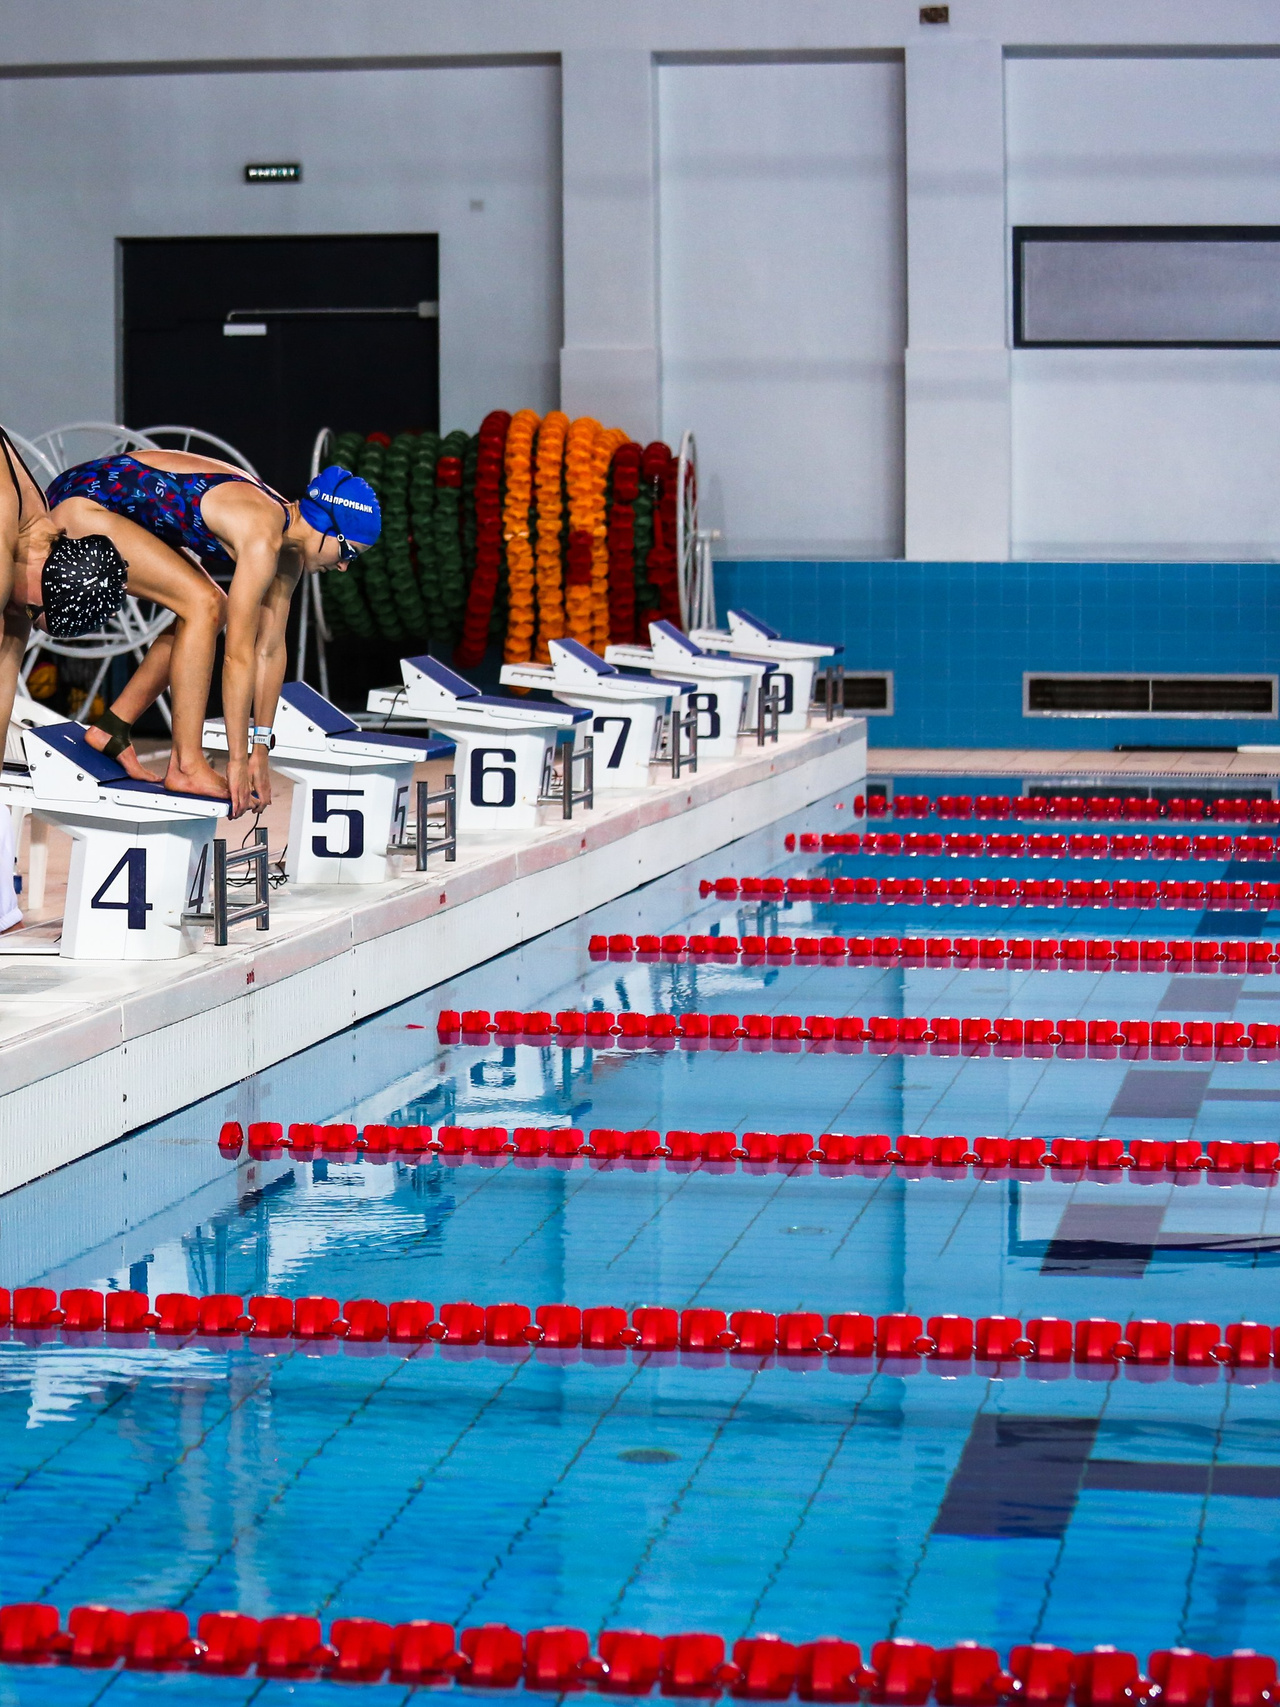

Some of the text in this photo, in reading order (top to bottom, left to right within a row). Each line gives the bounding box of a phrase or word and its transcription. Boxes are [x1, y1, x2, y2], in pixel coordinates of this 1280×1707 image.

[321, 493, 373, 514] ГАЗПРОМБАНК
[593, 717, 632, 768] 7
[686, 693, 721, 739] 8
[471, 748, 517, 807] 6
[312, 789, 365, 858] 5
[91, 848, 153, 929] 4
